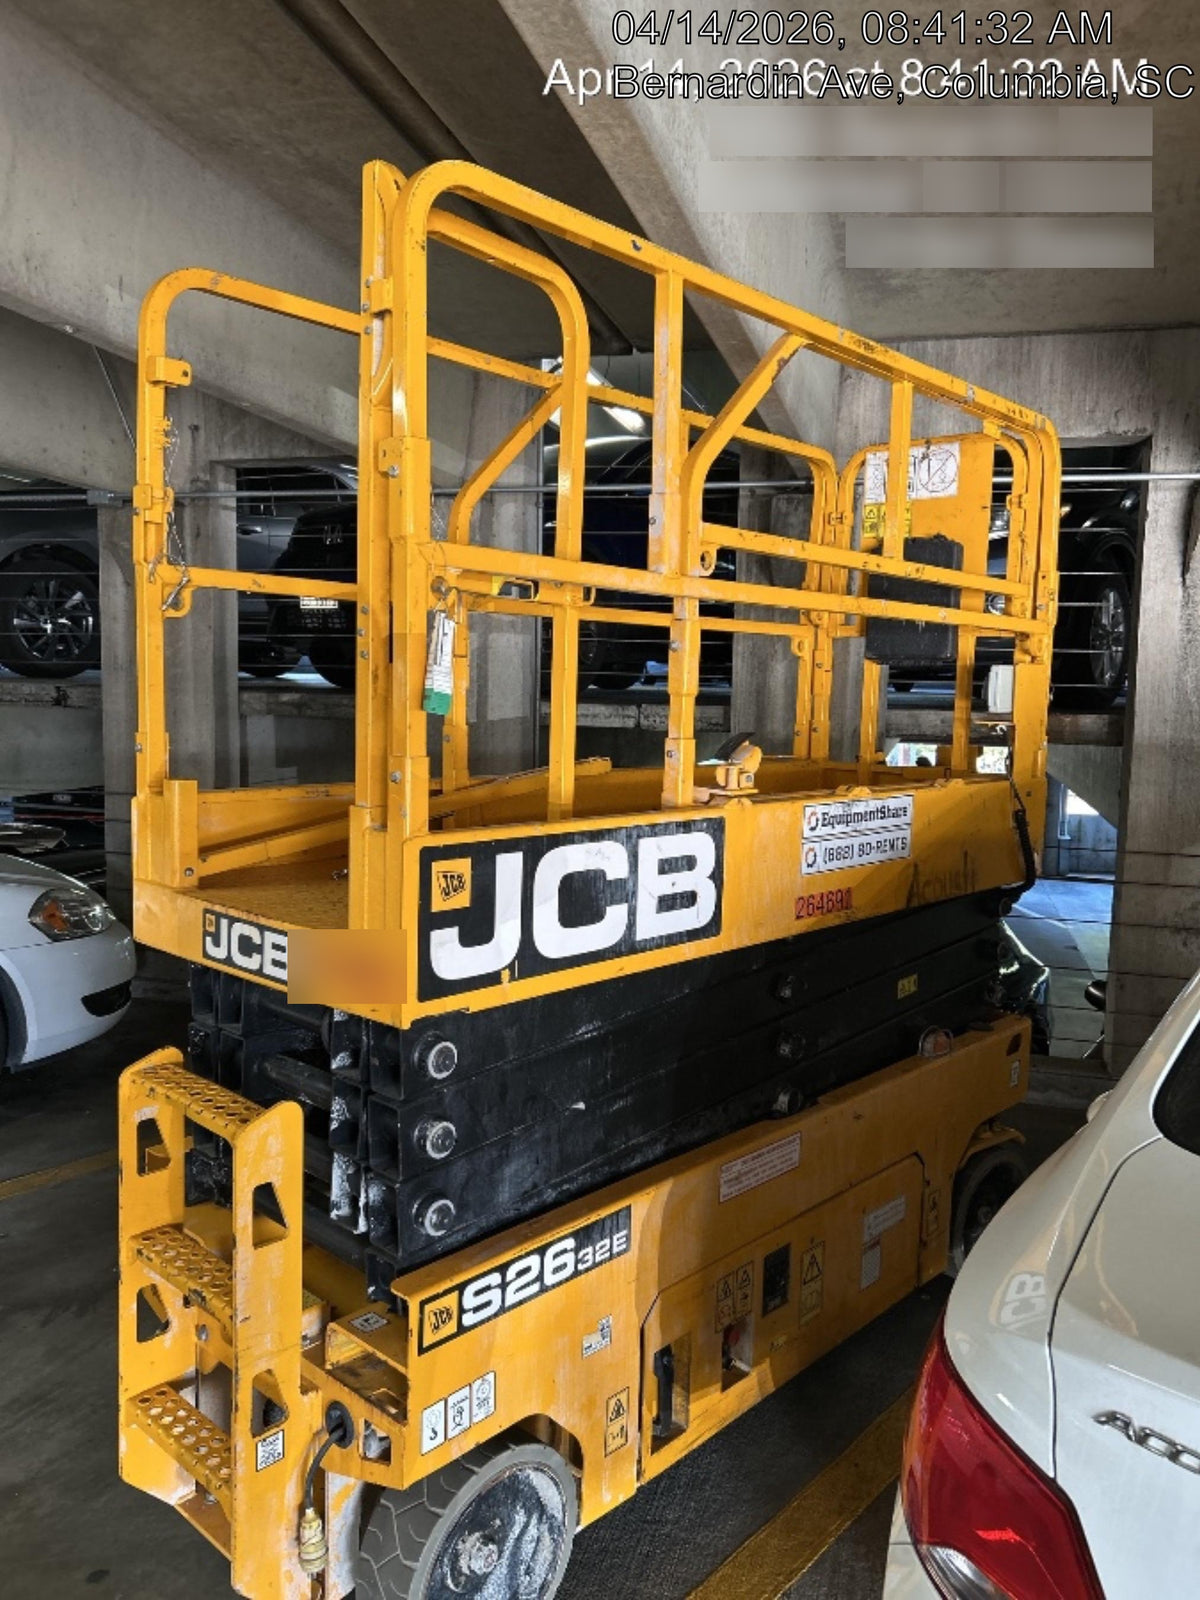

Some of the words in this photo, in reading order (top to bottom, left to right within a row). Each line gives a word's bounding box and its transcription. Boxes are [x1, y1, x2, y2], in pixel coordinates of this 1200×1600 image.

[820, 804, 909, 830] EquipmentShare
[440, 871, 467, 899] JCB
[429, 830, 717, 982] JCB
[430, 1305, 454, 1333] JCB
